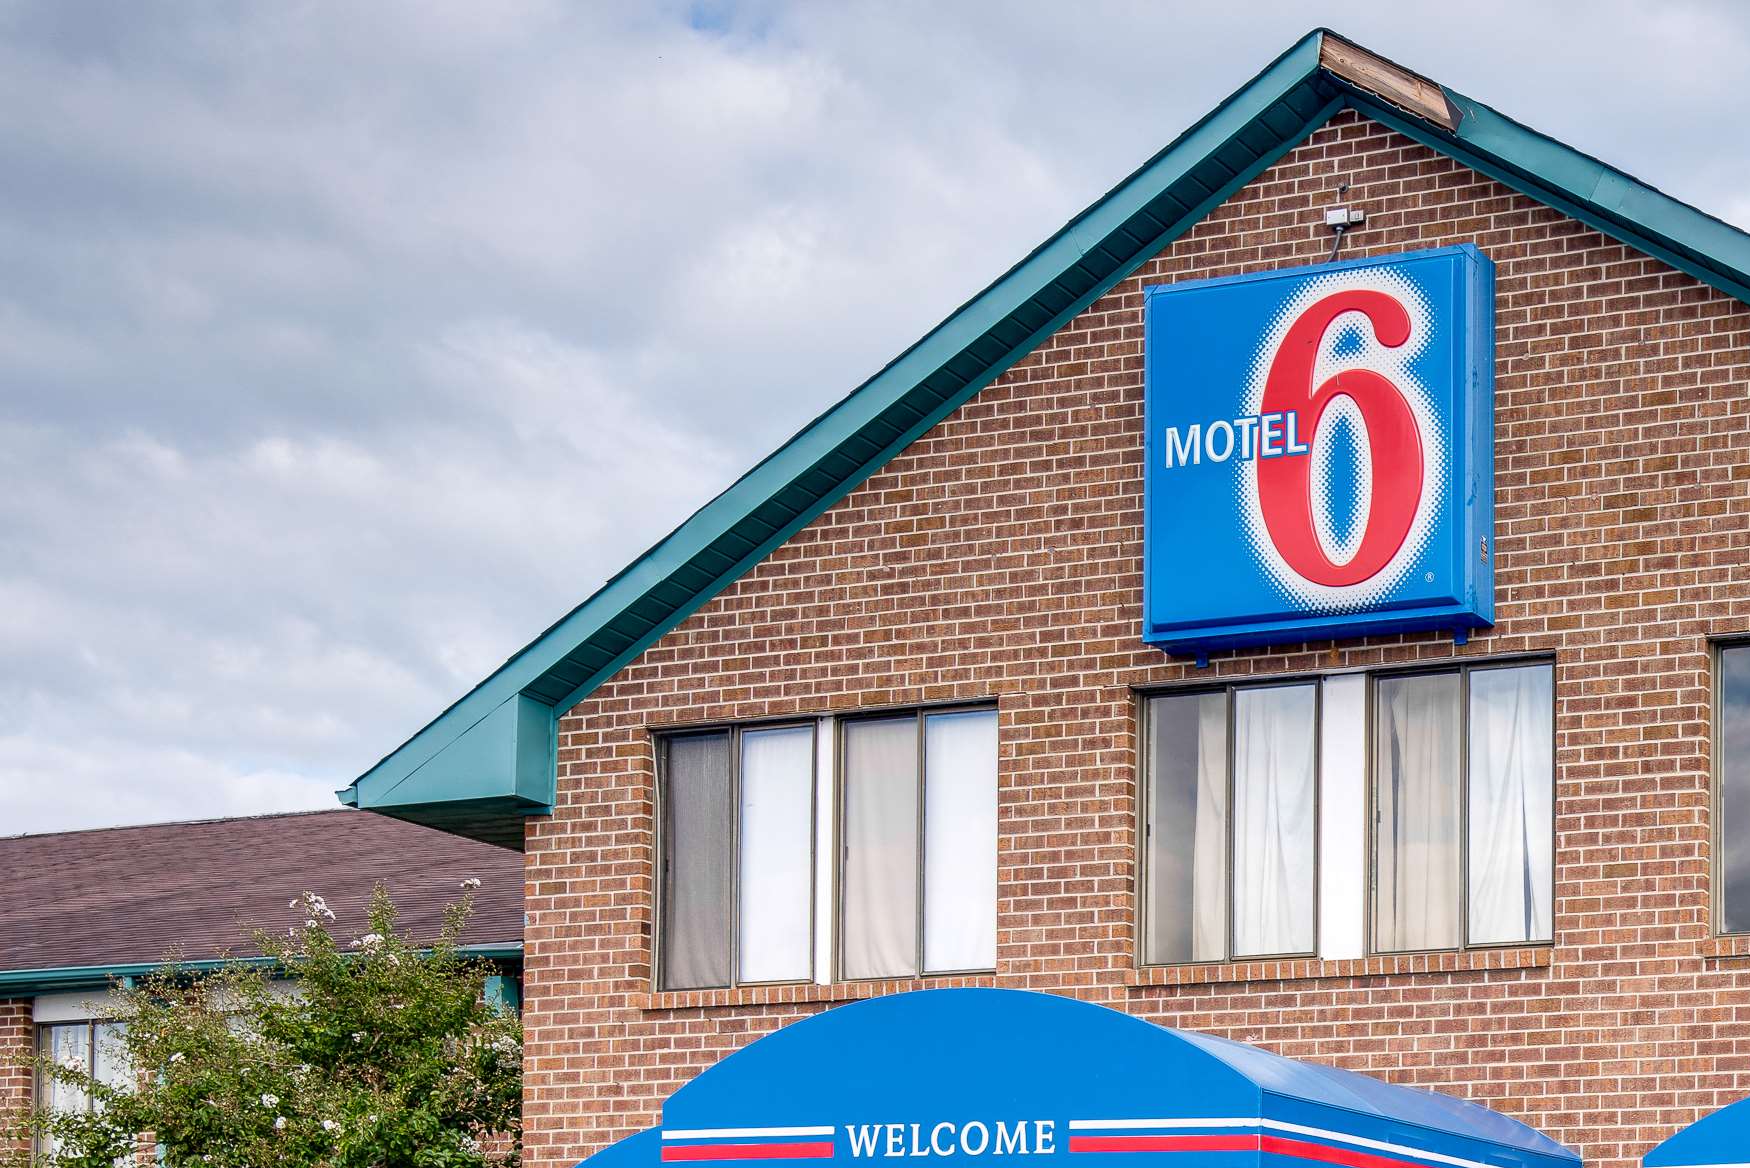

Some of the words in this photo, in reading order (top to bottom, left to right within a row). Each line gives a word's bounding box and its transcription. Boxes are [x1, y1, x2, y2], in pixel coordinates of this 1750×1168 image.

[1165, 411, 1309, 469] MOTEL
[1256, 289, 1425, 588] 6
[845, 1120, 1056, 1158] WELCOME
